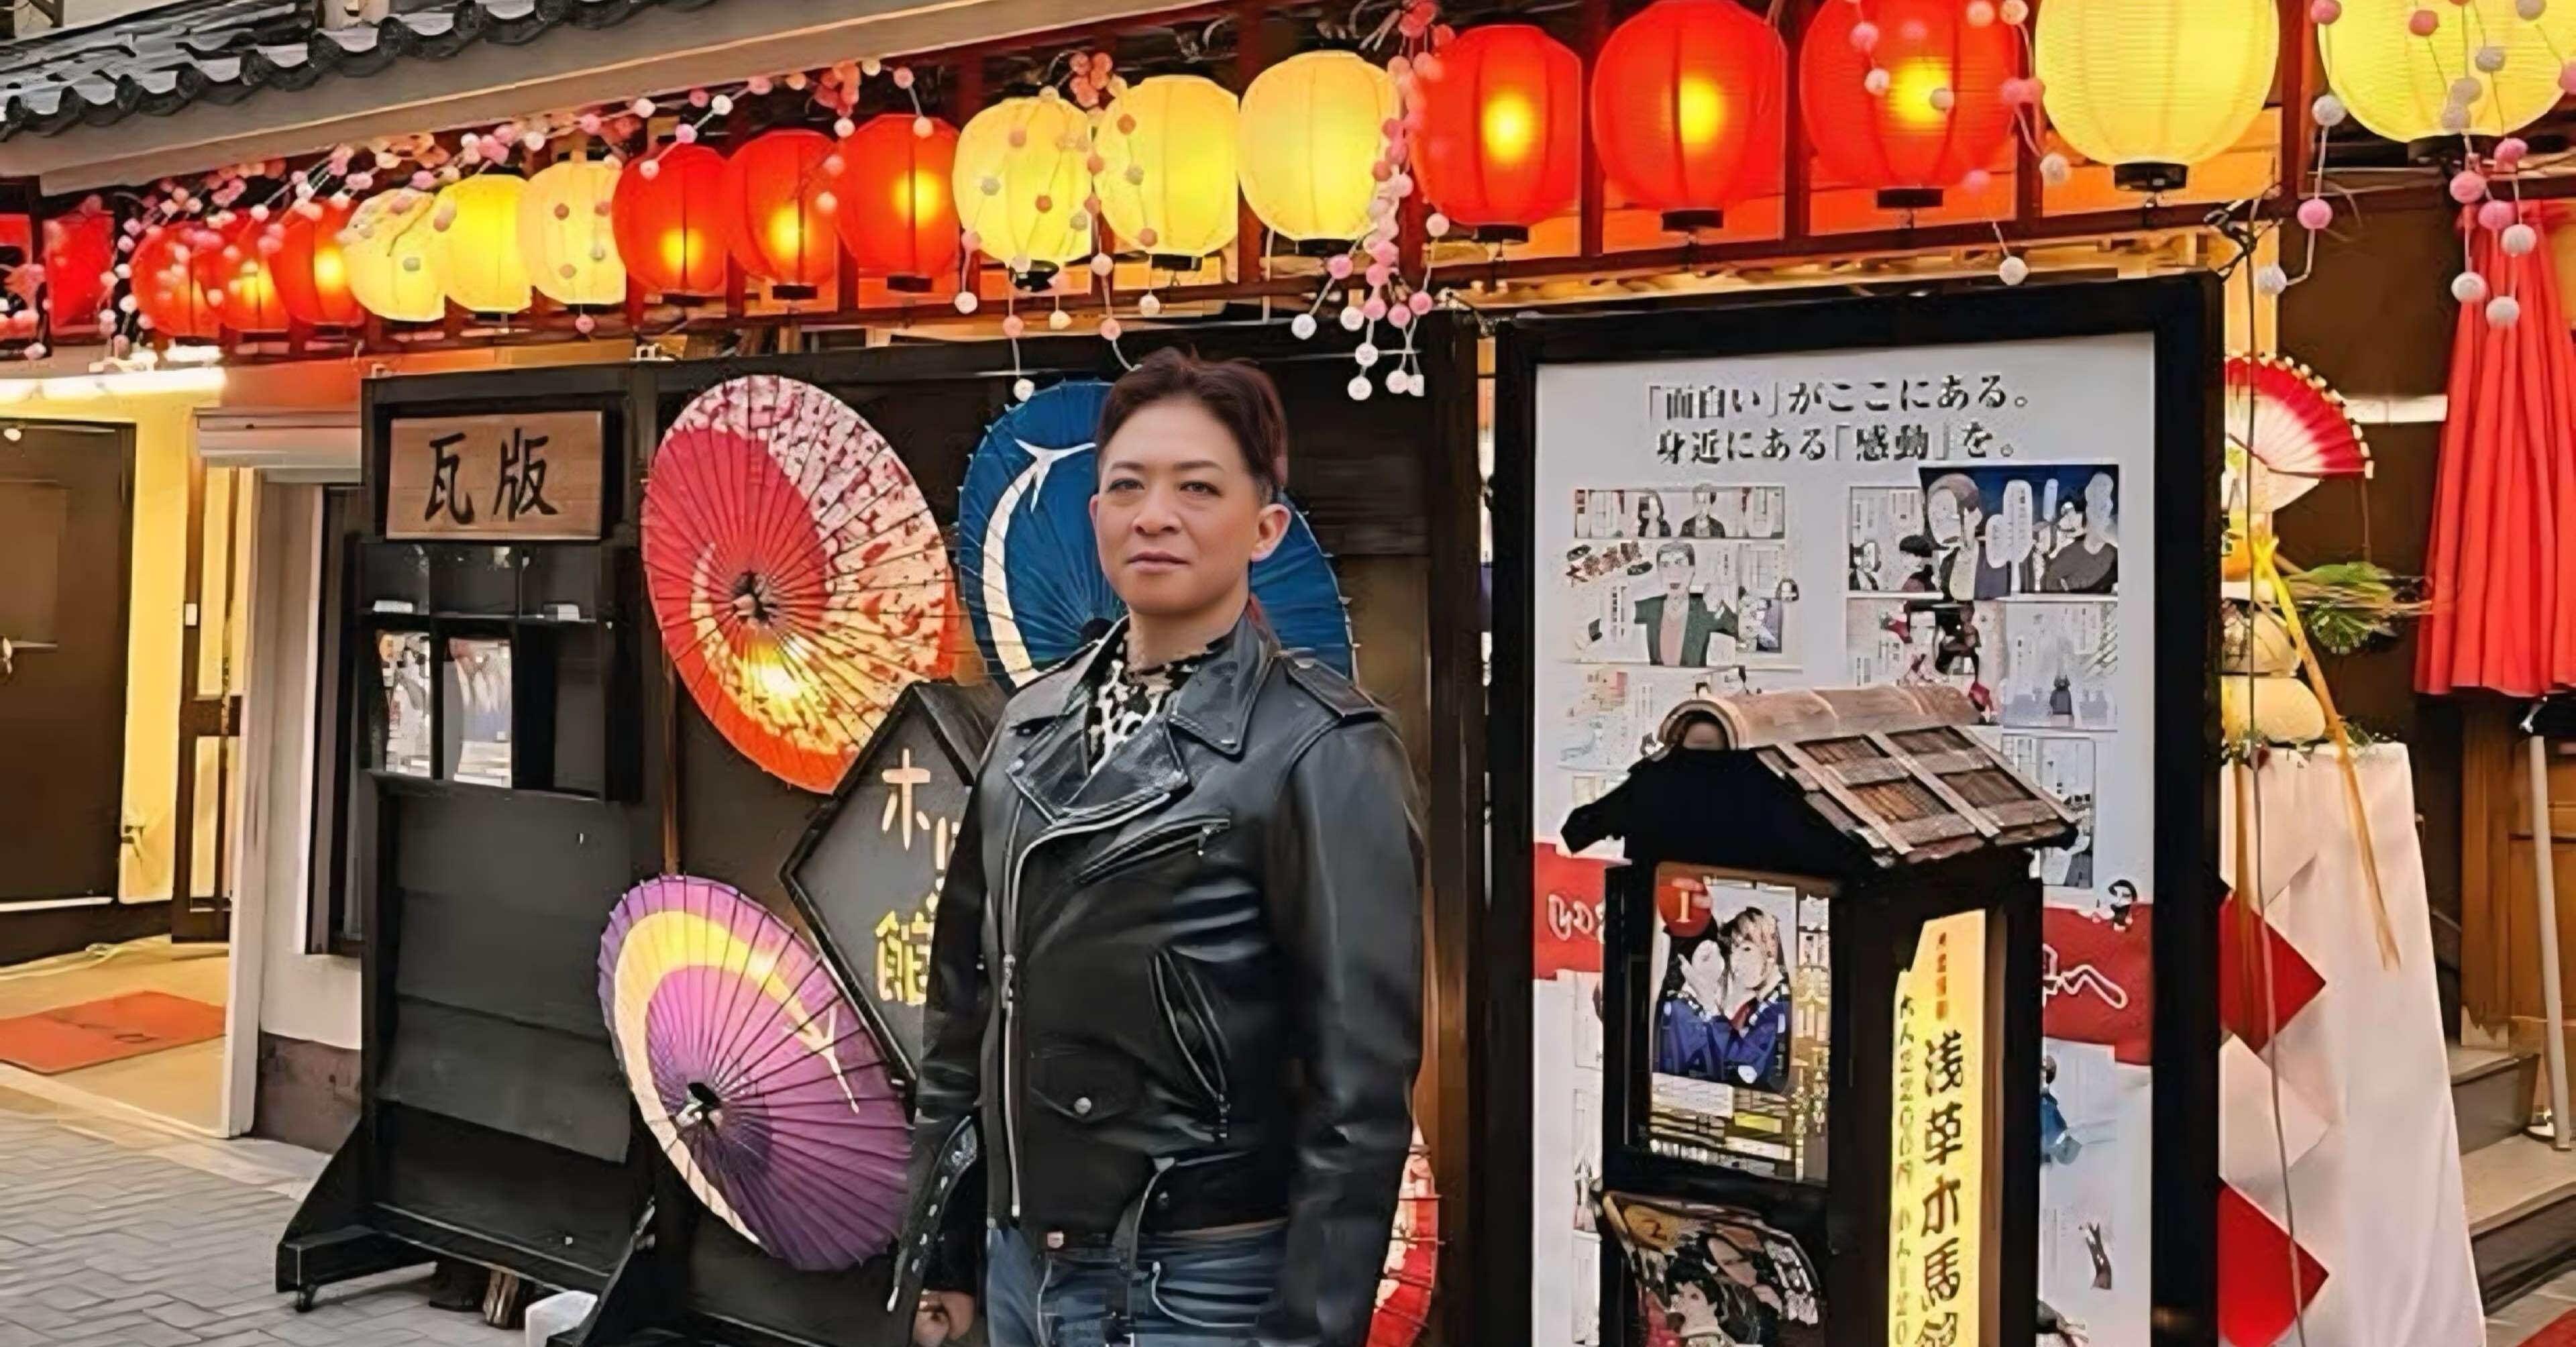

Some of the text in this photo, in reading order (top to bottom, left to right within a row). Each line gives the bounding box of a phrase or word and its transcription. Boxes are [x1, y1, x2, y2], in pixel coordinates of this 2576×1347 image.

[1650, 374, 2028, 424] 「面白い」がここにある。
[425, 427, 558, 525] 瓦版
[1657, 420, 2014, 466] 身近にある「感動」を。
[875, 748, 959, 1006] 木館
